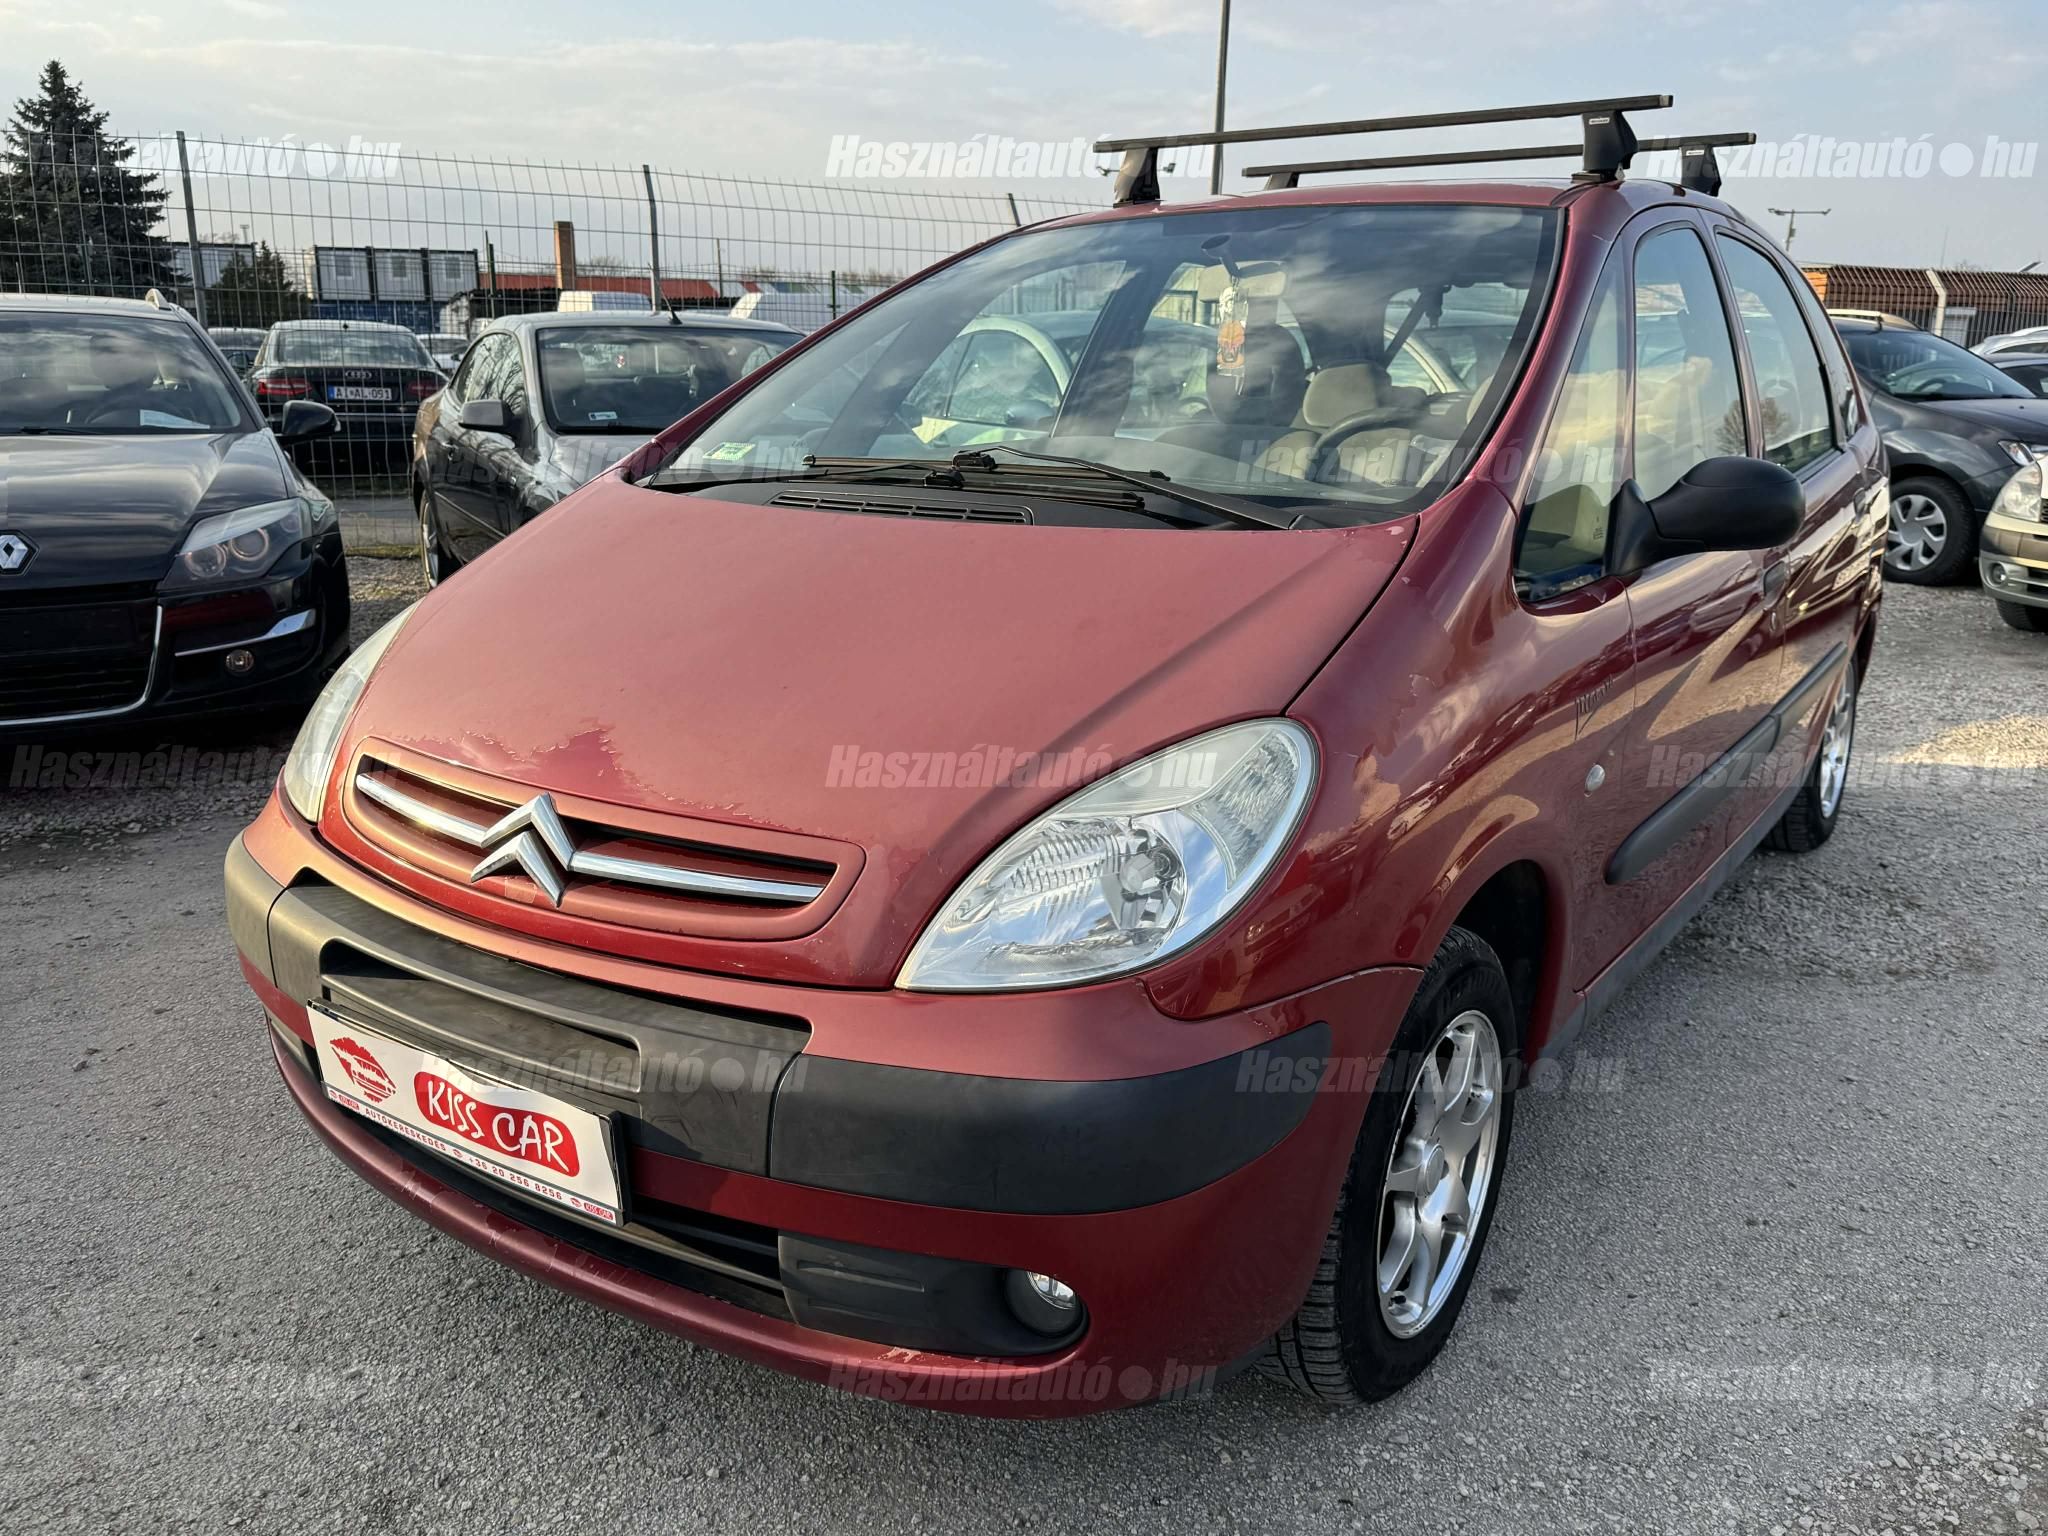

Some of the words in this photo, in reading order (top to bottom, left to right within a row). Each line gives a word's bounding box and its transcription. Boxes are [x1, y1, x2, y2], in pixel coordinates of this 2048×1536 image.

[427, 1080, 485, 1139] KISS
[492, 1112, 570, 1172] CAR
[492, 1166, 505, 1178] 20
[509, 1173, 530, 1188] 256
